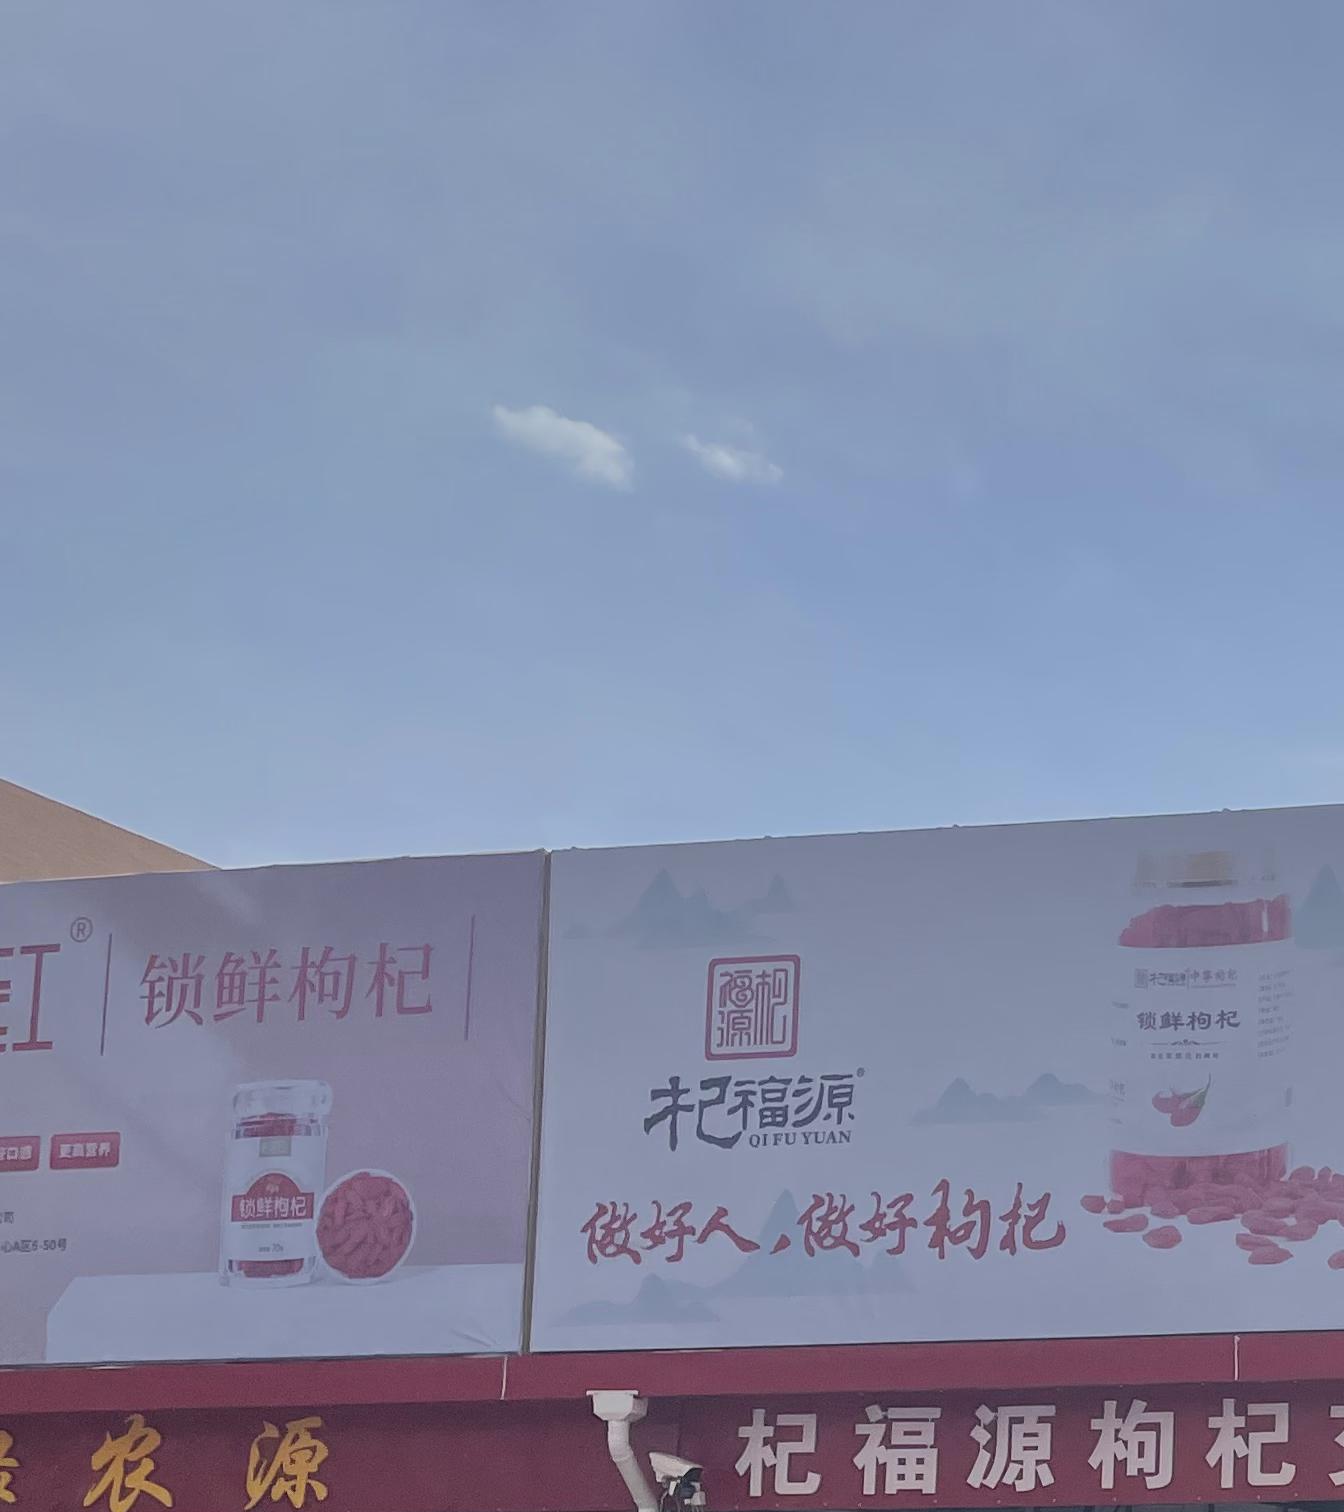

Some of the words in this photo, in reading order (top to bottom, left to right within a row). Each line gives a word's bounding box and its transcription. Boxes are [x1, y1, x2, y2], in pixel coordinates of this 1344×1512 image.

[139, 942, 434, 1029] 锁鲜枸杞
[1136, 1009, 1241, 1031] 锁鲜枸杞
[643, 1073, 857, 1152] 杞福源
[748, 1133, 769, 1149] QI
[772, 1131, 797, 1147] FU
[799, 1129, 853, 1147] YUAN
[239, 1196, 307, 1219] 锁鲜枸杞
